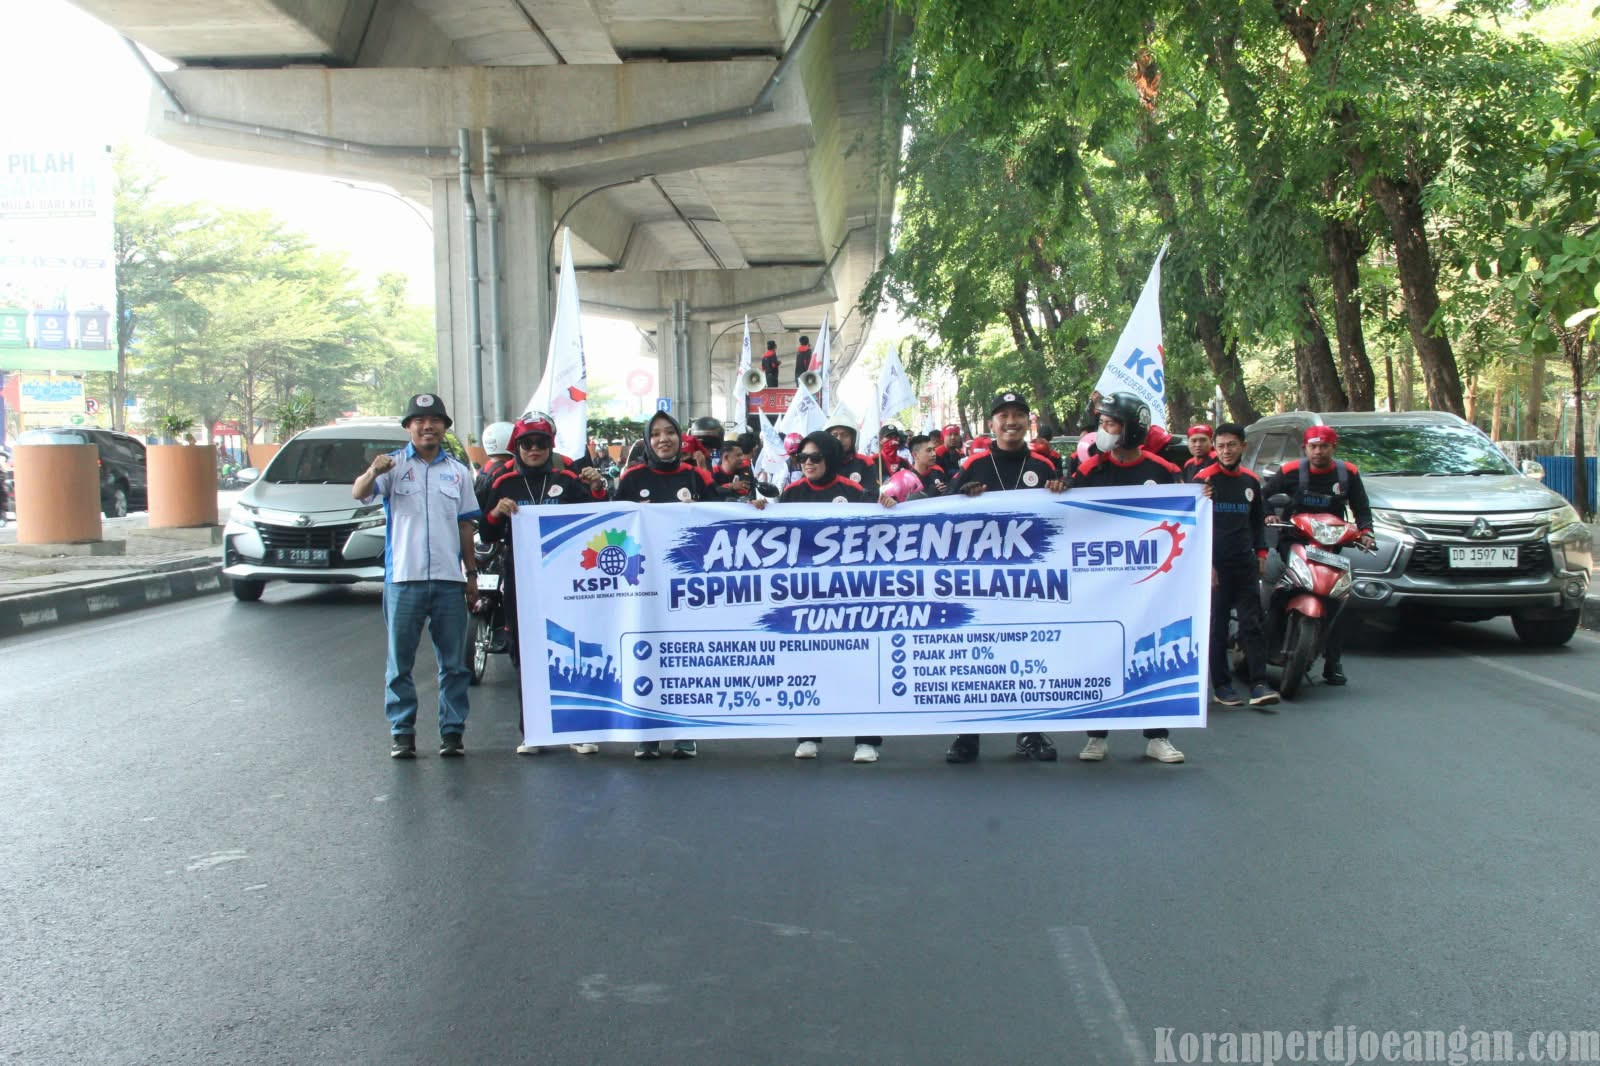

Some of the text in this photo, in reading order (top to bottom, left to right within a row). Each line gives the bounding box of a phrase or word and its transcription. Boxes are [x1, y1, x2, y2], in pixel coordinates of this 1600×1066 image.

[8, 152, 75, 174] PILAH
[1106, 364, 1153, 402] KONFEDERASI
[703, 519, 1034, 572] AKSI SERENTAK
[1072, 540, 1158, 567] FSPMI
[1452, 548, 1516, 561] DD 1597 NZ
[573, 577, 618, 592] KSPI
[669, 568, 1069, 609] FSPMI SULAWESI SELATAN
[791, 603, 932, 633] TUNTUTAN
[913, 629, 1061, 645] TETAPKAN UMSK/UMSP 2027
[659, 638, 870, 654] SEGERA SAHKAN UU PERLINDUNGAN
[913, 646, 994, 661] PAJAK JHT 0%
[659, 654, 776, 668] KETENAGAKERJAAN
[913, 659, 1048, 677] TOLAK PESANGON 0,5%
[660, 674, 817, 689] TETAPKAN UMK/UMP 2027
[914, 677, 1112, 693] REVISI KEMENAKER NO. 7 TAHUN 2026
[660, 693, 714, 705] SEBESAR
[717, 690, 761, 711] 7,5%
[776, 689, 821, 710] 9,0%
[914, 689, 1104, 705] TENTANG AHLI DAYA (OUTSOURCING)
